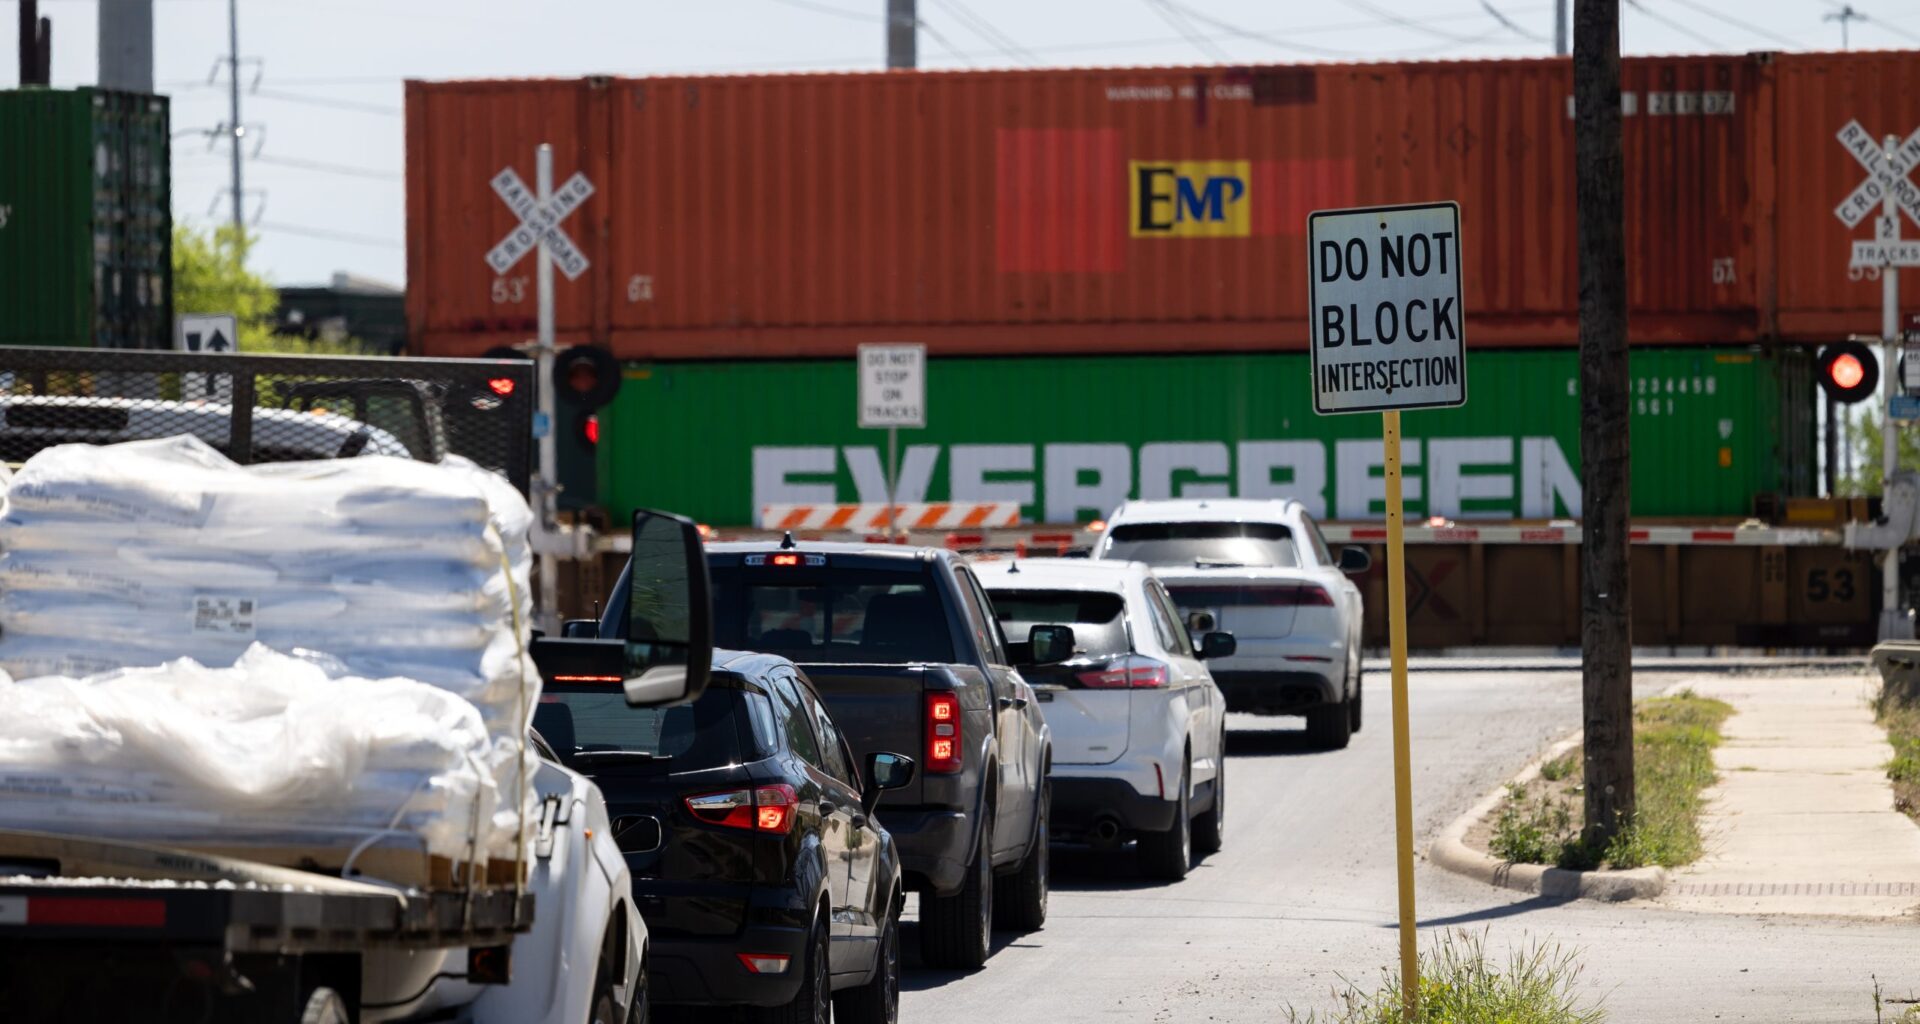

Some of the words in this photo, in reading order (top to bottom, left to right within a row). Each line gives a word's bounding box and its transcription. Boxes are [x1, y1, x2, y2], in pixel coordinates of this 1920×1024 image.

[1842, 125, 1920, 223] RAILROA
[1137, 166, 1245, 231] EMP
[491, 180, 587, 269] CROSSING
[500, 174, 583, 274] RAILROAD
[1320, 237, 1369, 283] DO
[1380, 231, 1453, 279] NOT
[1857, 246, 1919, 261] TRACKS
[1322, 296, 1457, 348] BLOCK
[867, 353, 885, 367] DO
[890, 353, 916, 366] NOT
[874, 370, 909, 384] STOP
[1321, 355, 1458, 393] INTERSECTION
[867, 405, 918, 419] TRACKS
[882, 388, 903, 401] ON
[752, 436, 1583, 529] EVERGREEN
[1806, 567, 1856, 603] 53
